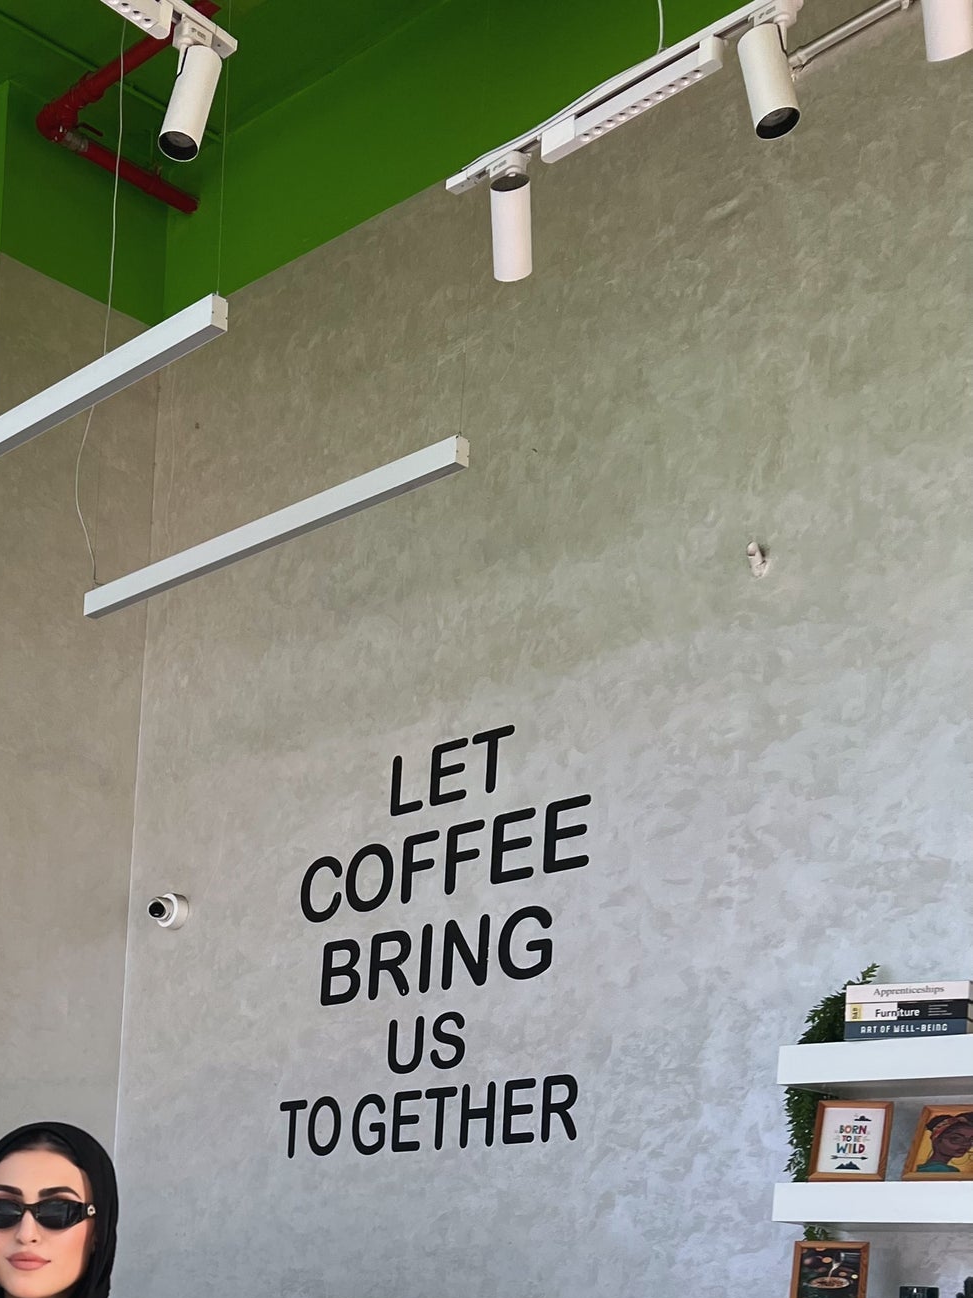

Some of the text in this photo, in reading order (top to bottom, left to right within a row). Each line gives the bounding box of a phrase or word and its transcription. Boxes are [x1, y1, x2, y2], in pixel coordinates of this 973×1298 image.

[390, 724, 515, 816] LET
[300, 793, 592, 923] COFFEE
[320, 905, 553, 1006] BRING
[873, 985, 945, 997] Apprenticeships
[860, 1024, 948, 1034] ART OF WELL-BEING
[875, 1008, 921, 1017] Furniture
[387, 1011, 465, 1074] US
[279, 1074, 578, 1159] TOGETHER
[839, 1124, 867, 1135] BORN
[836, 1143, 866, 1154] WILD
